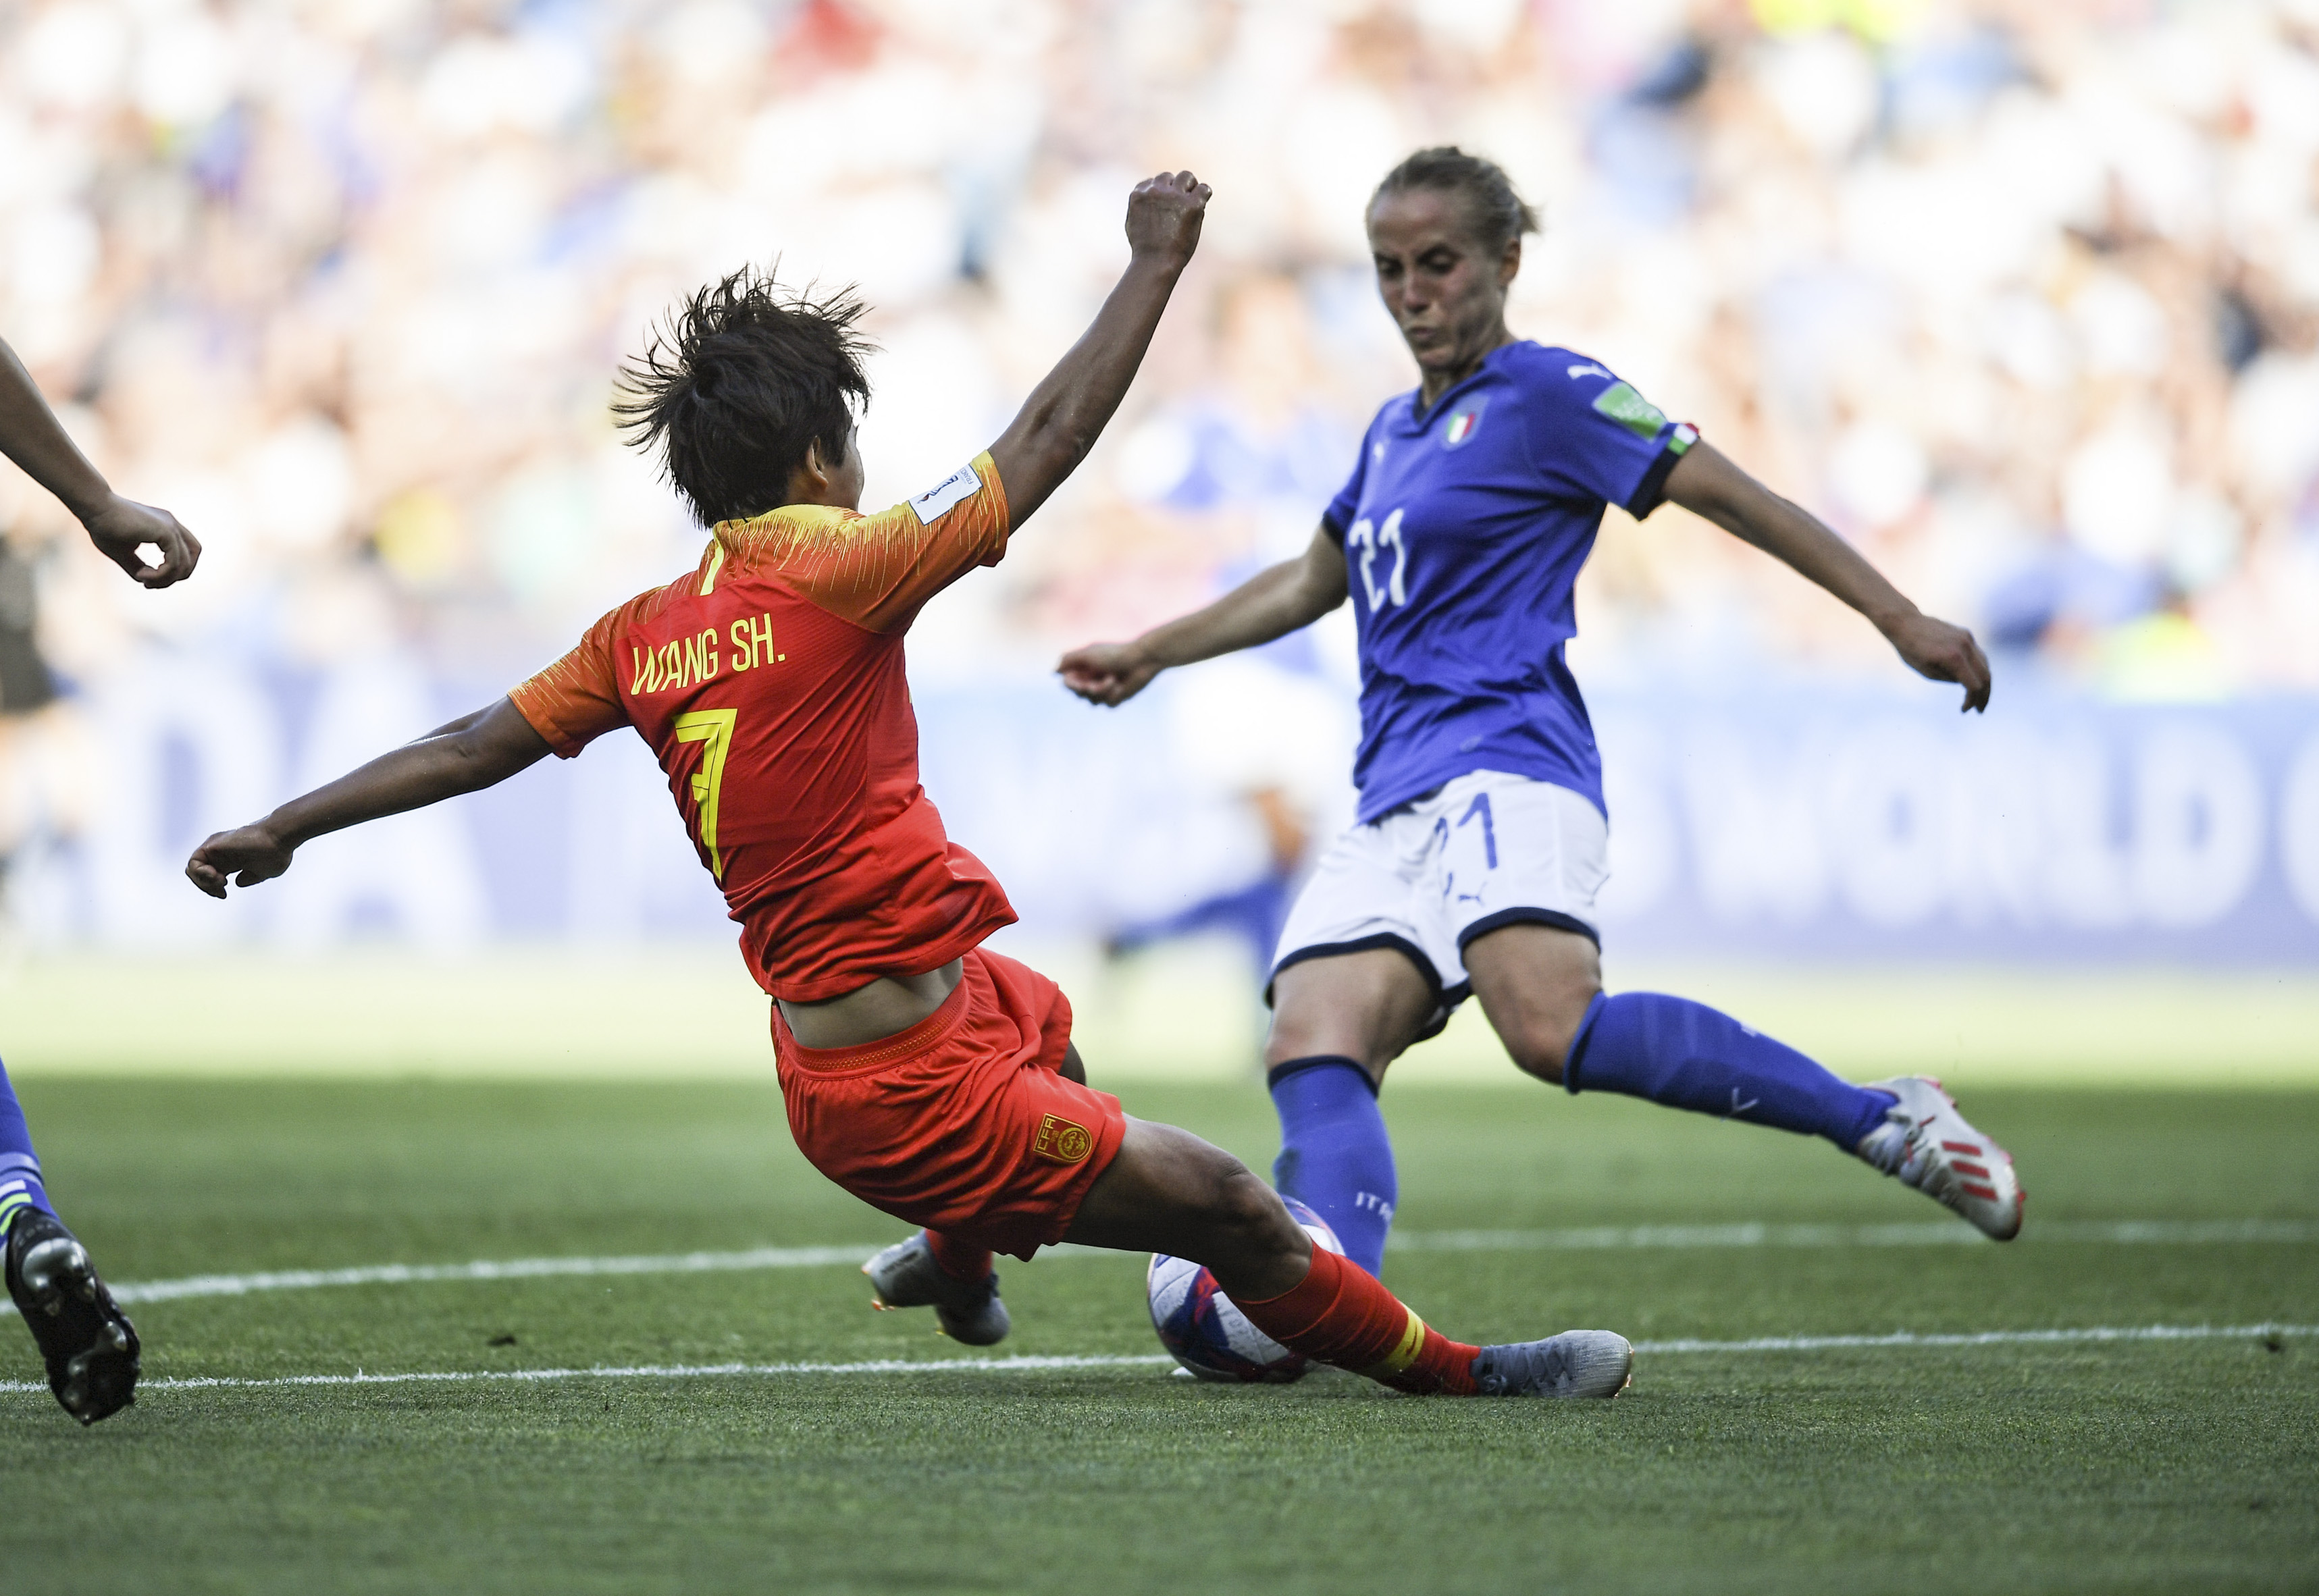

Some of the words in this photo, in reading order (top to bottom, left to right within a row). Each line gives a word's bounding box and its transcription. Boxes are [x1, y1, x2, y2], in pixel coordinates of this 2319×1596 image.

[1349, 508, 1407, 613] 21
[631, 629, 718, 695] WANG
[731, 613, 785, 672] SH.
[673, 708, 738, 882] 7
[1675, 716, 2268, 929] WORLD
[1037, 1117, 1056, 1150] CFA
